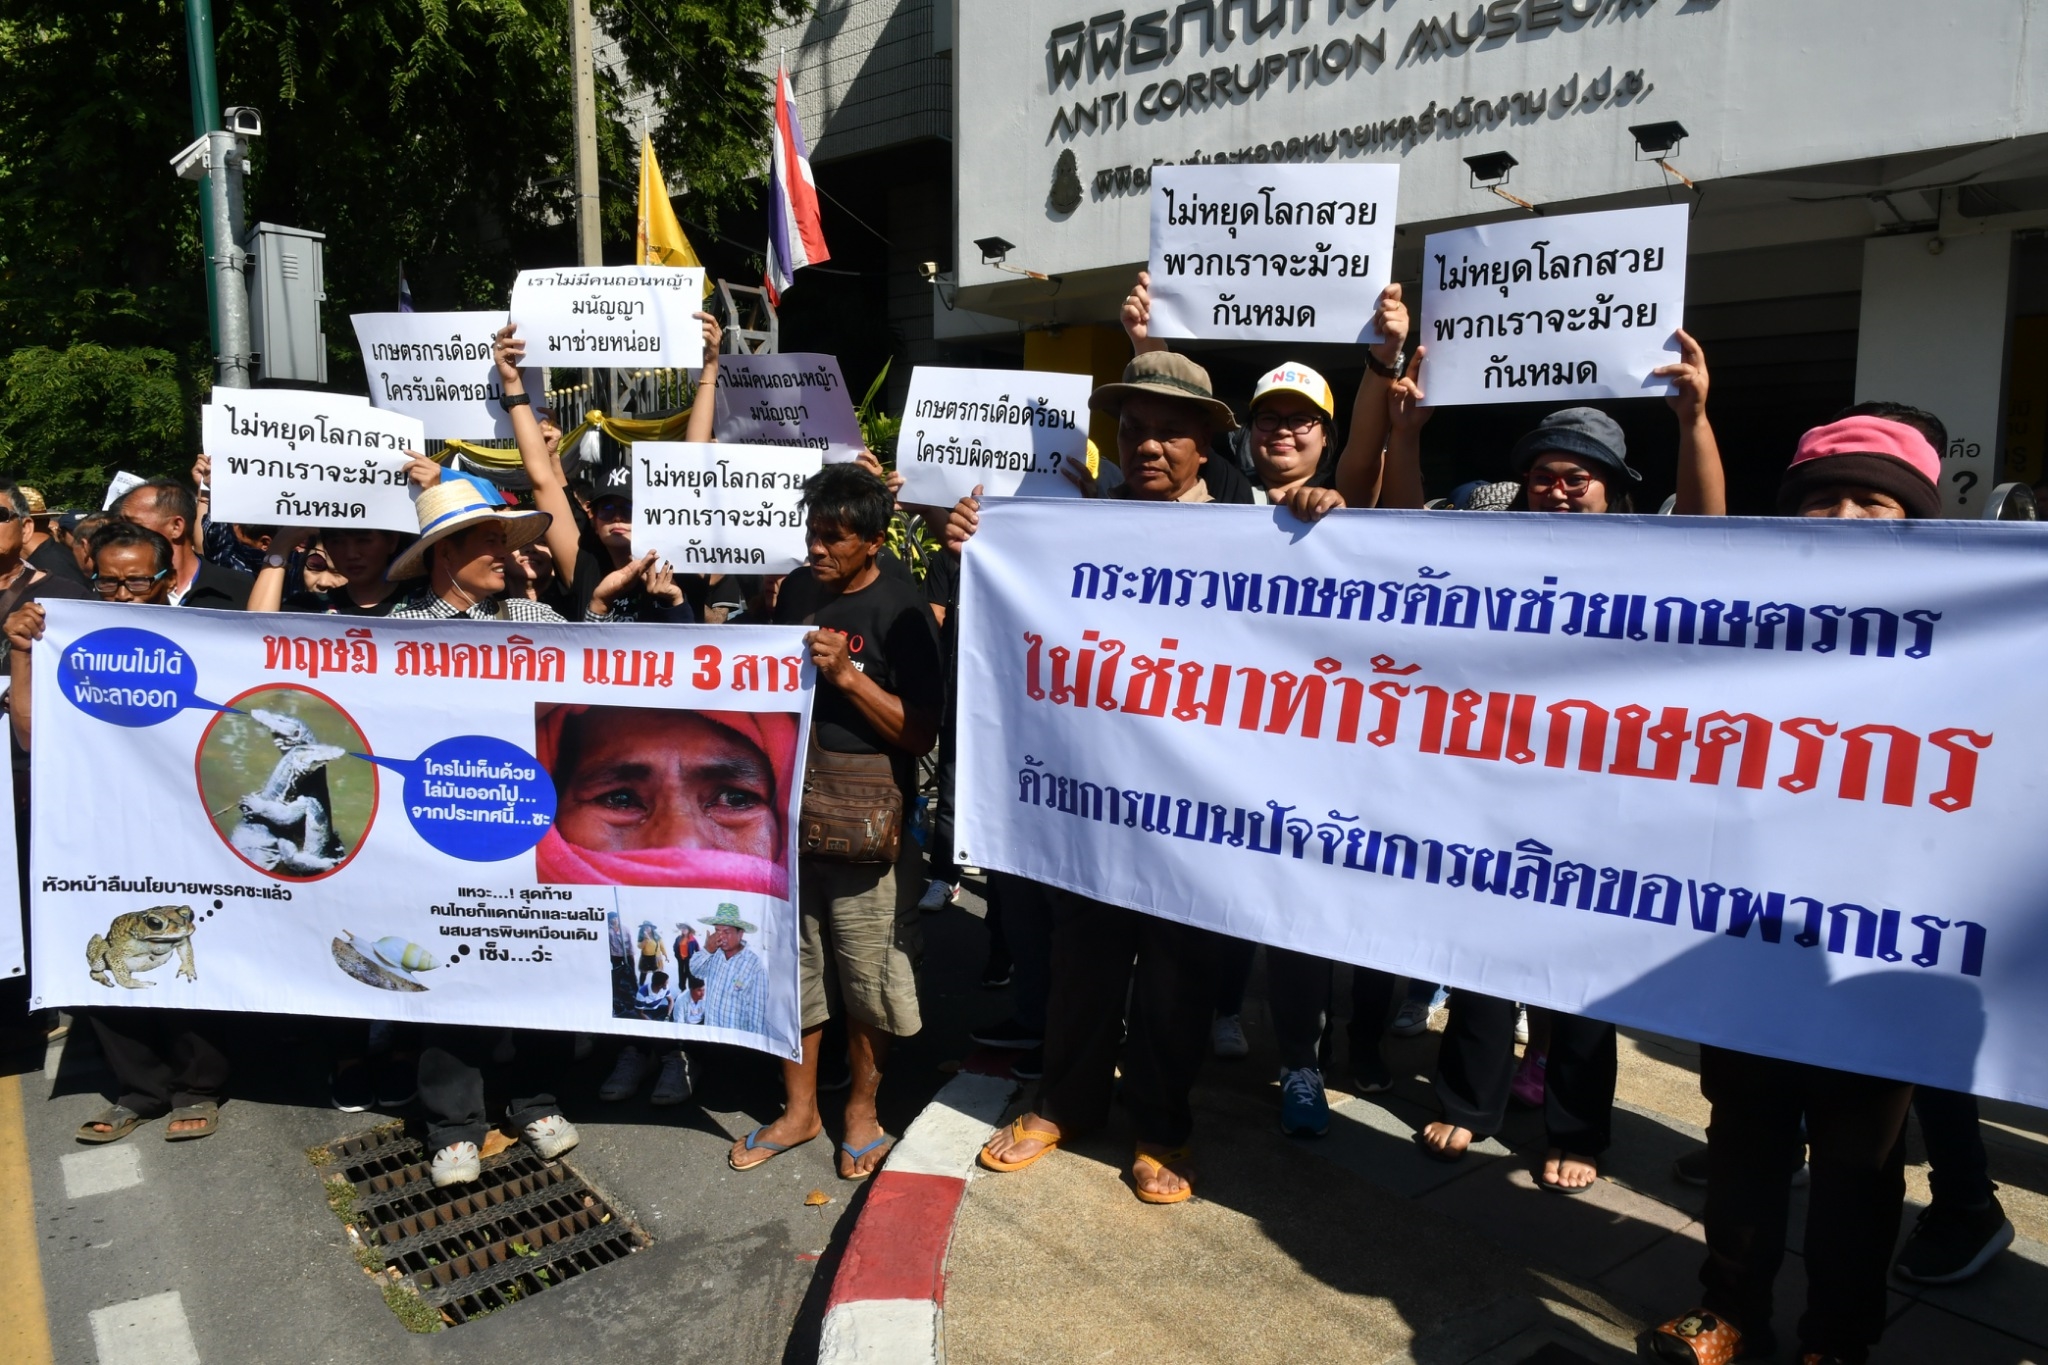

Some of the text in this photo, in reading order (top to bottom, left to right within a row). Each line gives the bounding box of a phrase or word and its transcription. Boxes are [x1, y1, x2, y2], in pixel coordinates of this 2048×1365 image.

[1050, 90, 1128, 138] ANTI
[1140, 27, 1385, 116] CORRUPTION
[1559, 65, 1654, 107] ป.ป.ช.
[1162, 186, 1377, 239] ไม่หยุดโลกสวย
[1163, 242, 1369, 277] พวกเราจะม้วย
[1434, 239, 1664, 298] ไม่หยุดโลกสวย
[528, 272, 693, 290] เราไม่มีคนถอนหญ้า
[572, 295, 644, 321] มนัญญา
[1213, 293, 1316, 327] กันหมด
[1434, 293, 1657, 341] พวกเราจะม้วย
[372, 334, 496, 361] เกษตรกรเดือด
[548, 329, 661, 352] มาช่วยหน่อย
[1484, 355, 1598, 389] กันหมด
[224, 404, 412, 450] ไม่หยุดโลกสวย
[751, 401, 809, 426] มนัญญา
[916, 394, 1075, 430] เกษตรกรเดือดร้อน
[916, 430, 1062, 474] ใครรับผิดชอบ..?
[228, 456, 409, 486] พวกเราจะม้วย
[641, 458, 806, 497] ไม่หยุดโลกสวย
[275, 491, 366, 518] กันหมด
[644, 501, 802, 528] พวกเราจะม้วย
[685, 539, 766, 565] กันหมด
[1071, 562, 1943, 660] กระทรวงเกษตรต้องช่วยเกษตรกร
[71, 647, 183, 675] ถ้าแบนไม่ได้
[394, 634, 566, 683] สมคบคิด
[583, 648, 675, 687] แบน
[692, 644, 722, 691] 3
[731, 654, 804, 692] สาร
[74, 675, 178, 709] พี่จะลาออก
[1023, 629, 1994, 814] ไม่ใช่มาทำร้ายเกษตรกร
[424, 758, 536, 781] ใครไม่เห็นด้วย
[423, 780, 537, 803] ไล่มันออกไป...
[411, 802, 550, 826] จากประเทศนี้...ซะ
[1018, 755, 1987, 978] ด้วยการแบนปัจจัยการผลิตของพวกเรา
[42, 875, 292, 901] หัวหน้าลืมนโยบายพรรคซะแล้ว
[519, 886, 573, 904] สุดท้าย
[430, 902, 606, 923] คนไทยก็แดกผักและผลไม้
[439, 924, 599, 942] ผสมสารพิษเหมือนเดิม
[479, 941, 553, 962] เซ็ง...ว่ะ
